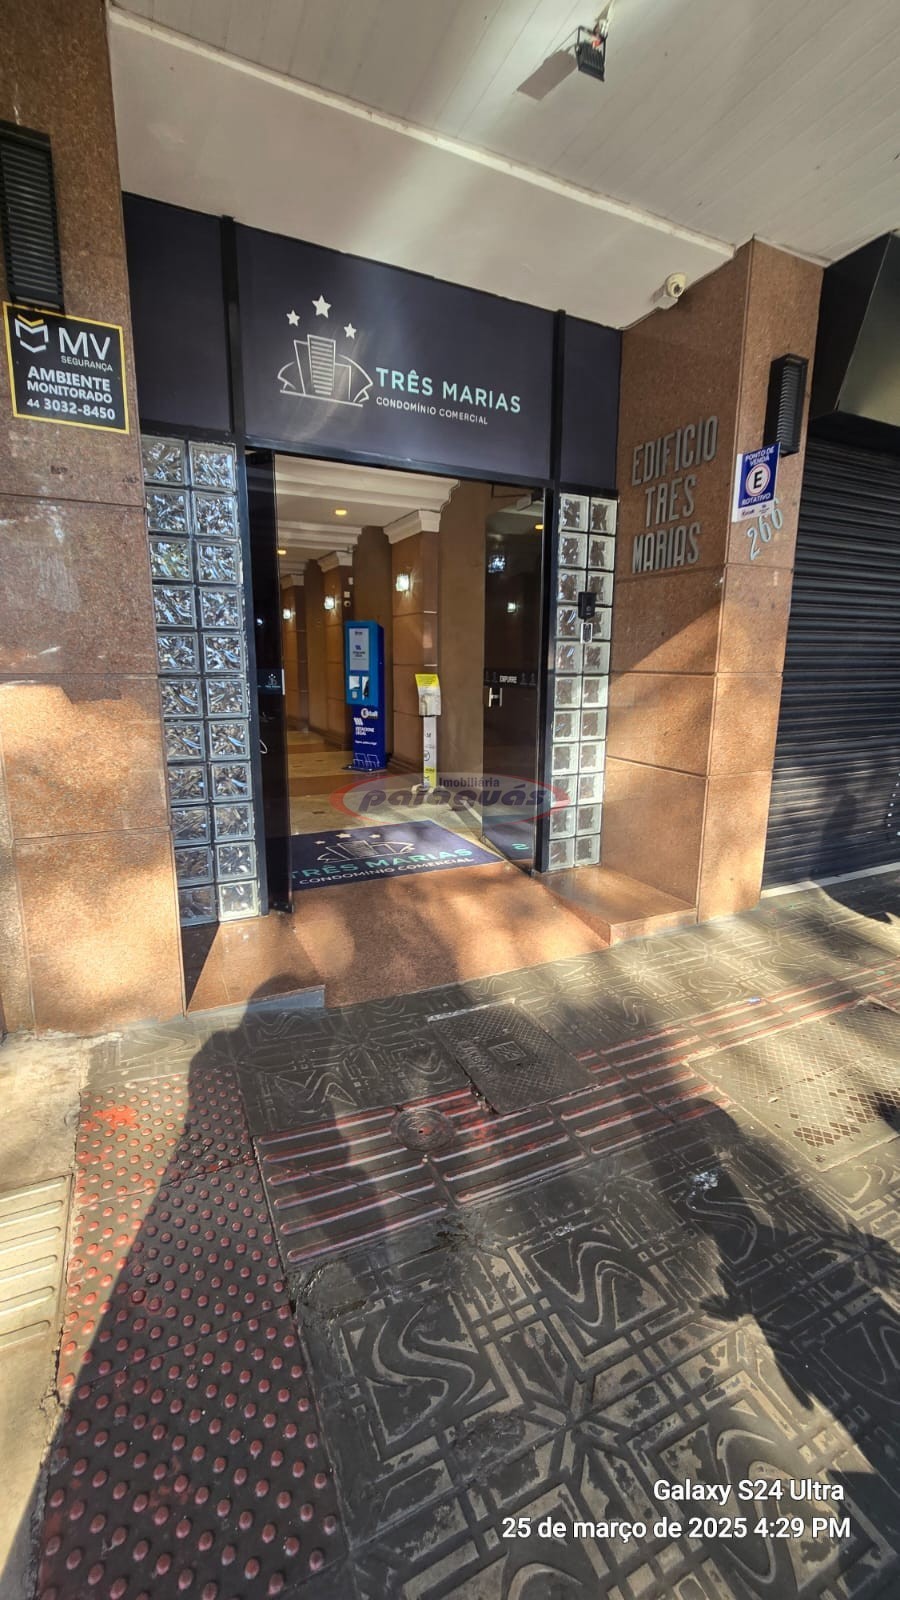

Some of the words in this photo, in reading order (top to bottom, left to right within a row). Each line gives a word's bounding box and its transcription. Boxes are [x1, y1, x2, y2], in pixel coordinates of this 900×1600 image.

[58, 326, 111, 361] MV
[60, 355, 113, 372] SEGURANÇA
[28, 365, 111, 392] AMBIENTE
[375, 367, 433, 396] TRÊS
[442, 381, 521, 413] MARIAS
[26, 380, 113, 404] MONITORADO
[26, 398, 40, 408] 44
[43, 398, 116, 420] 3032-8450
[376, 396, 437, 415] CONDOMÍNIO
[439, 408, 488, 424] COMERCIAL
[631, 415, 718, 487] EDIFICIO
[744, 449, 766, 463] PONTO
[753, 470, 763, 490] E
[645, 474, 697, 528] TRES
[741, 492, 771, 506] ROTATIVO
[631, 522, 701, 574] MARIAS
[366, 848, 472, 868] MARIAS
[398, 857, 475, 871] COMERCIAL
